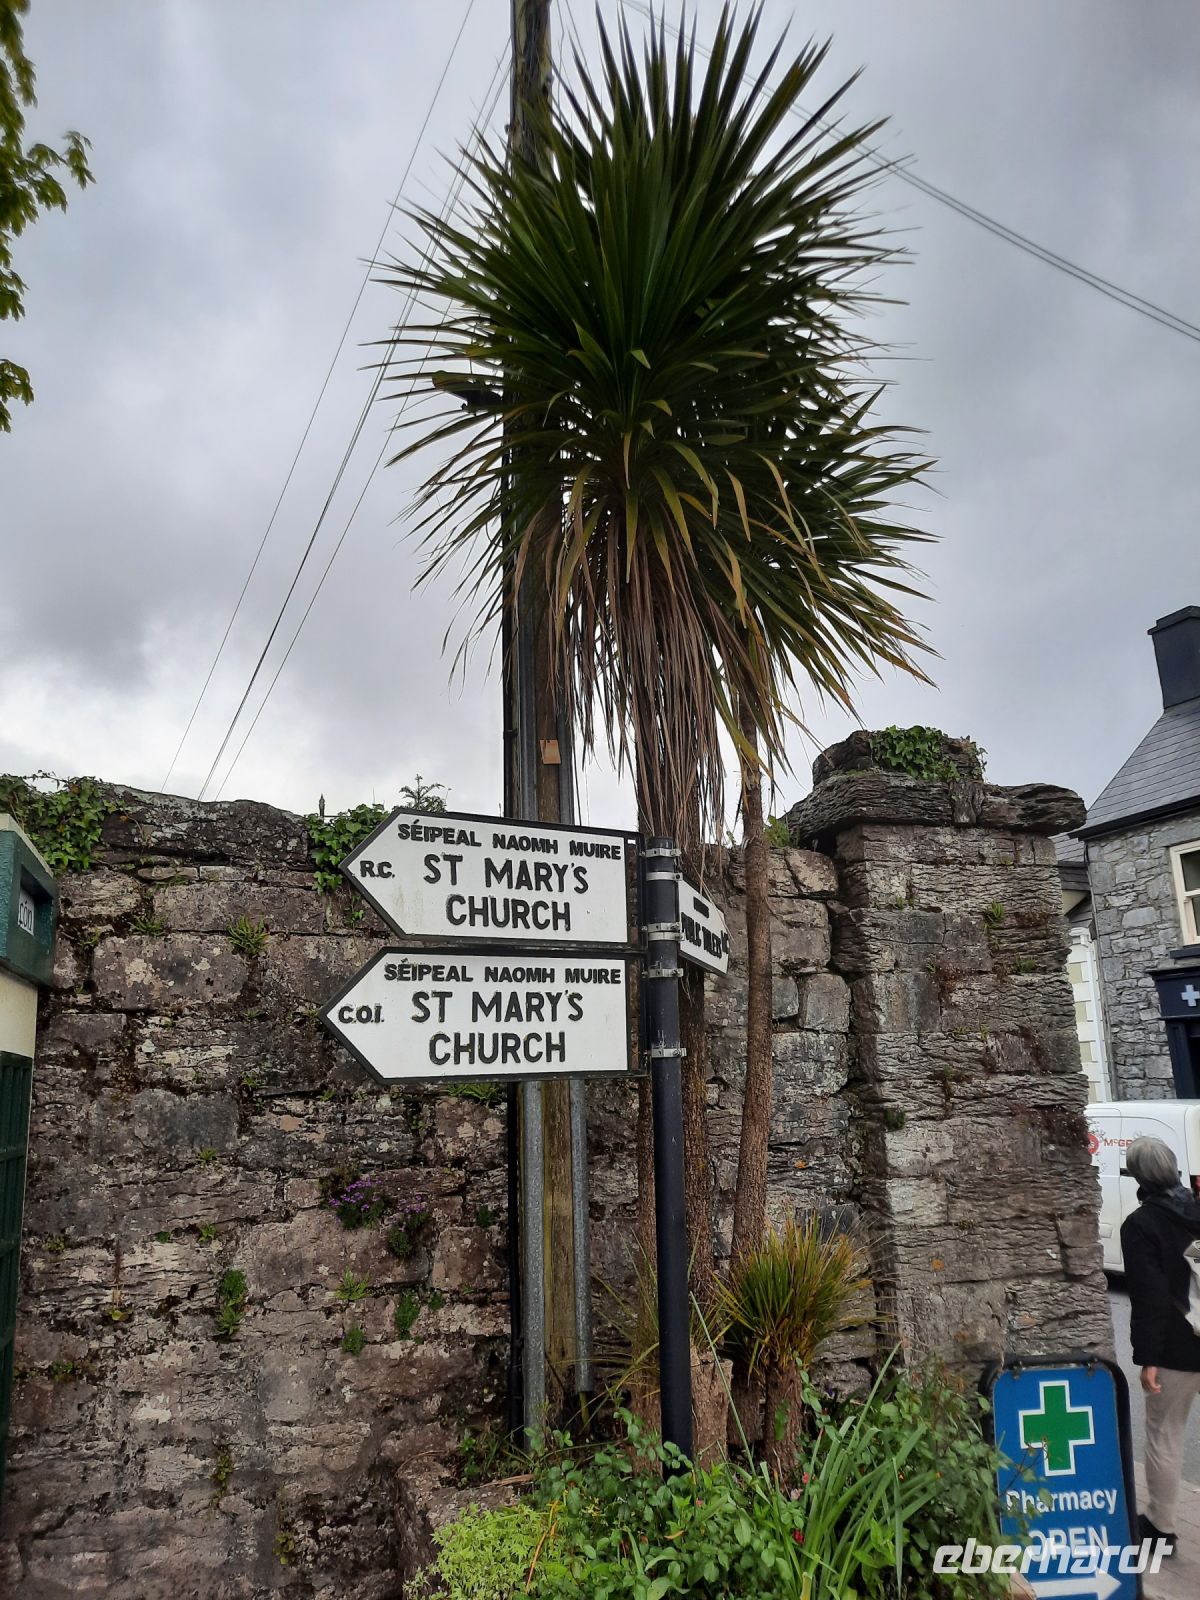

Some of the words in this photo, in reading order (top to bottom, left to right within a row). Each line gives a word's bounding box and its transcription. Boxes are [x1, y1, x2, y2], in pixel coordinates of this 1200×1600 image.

[398, 819, 481, 847] SÉIPEAL
[492, 833, 558, 854] NAOMH
[569, 839, 621, 860] MUIRE
[360, 860, 395, 879] R.C.
[423, 853, 463, 886] ST
[484, 857, 589, 894] MARY'S
[446, 894, 571, 931] CHURCH
[384, 958, 473, 982] SÉIPEAL
[484, 966, 555, 984] NAOMH
[565, 968, 621, 984] MUIRE
[338, 1005, 384, 1024] C.O.I.
[411, 990, 452, 1023] ST
[472, 989, 584, 1022] MARY'S
[429, 1031, 565, 1065] CHURCH
[1027, 1525, 1110, 1563] OPEN
